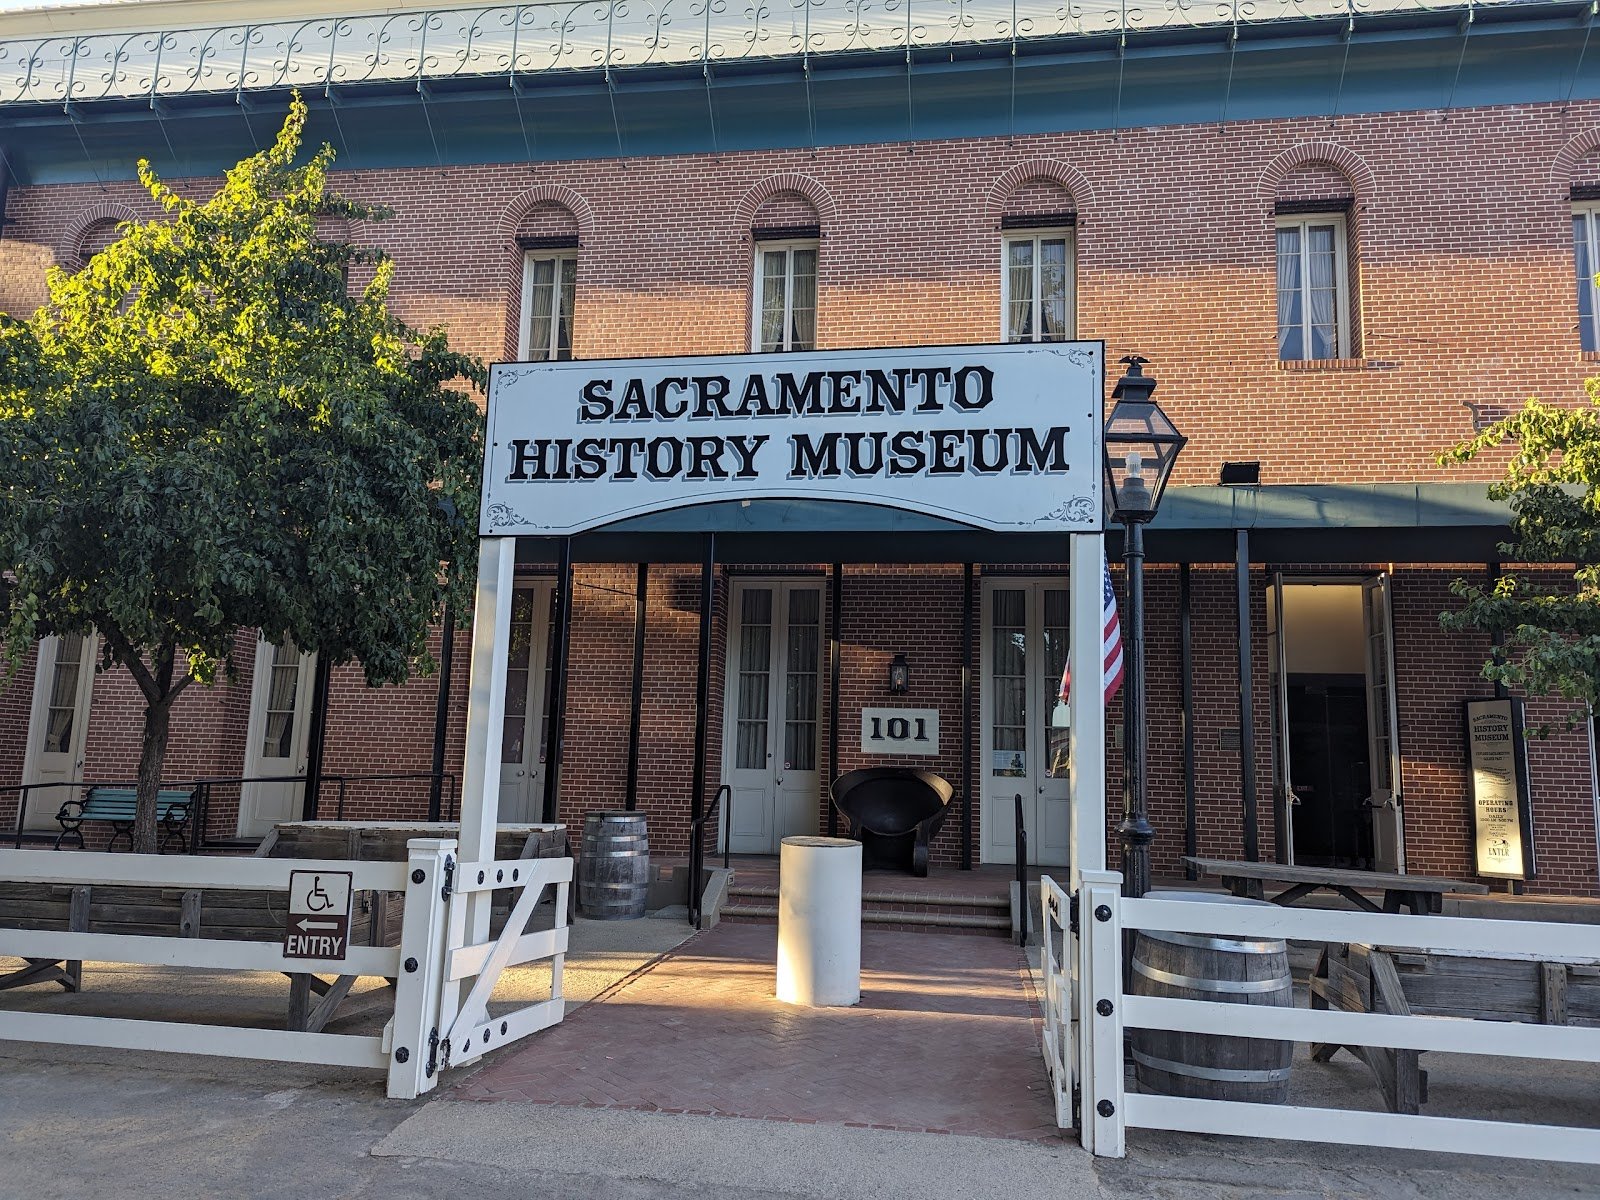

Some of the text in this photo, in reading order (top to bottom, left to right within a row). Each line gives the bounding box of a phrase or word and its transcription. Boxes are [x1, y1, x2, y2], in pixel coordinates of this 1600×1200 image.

[577, 365, 995, 424] SACRAMENTO
[505, 426, 1070, 484] HISTORY MUSEUM
[870, 717, 929, 741] 101
[1473, 714, 1508, 722] SACRAMENTO
[1488, 848, 1509, 856] ENTER
[286, 935, 343, 956] ENTRY
